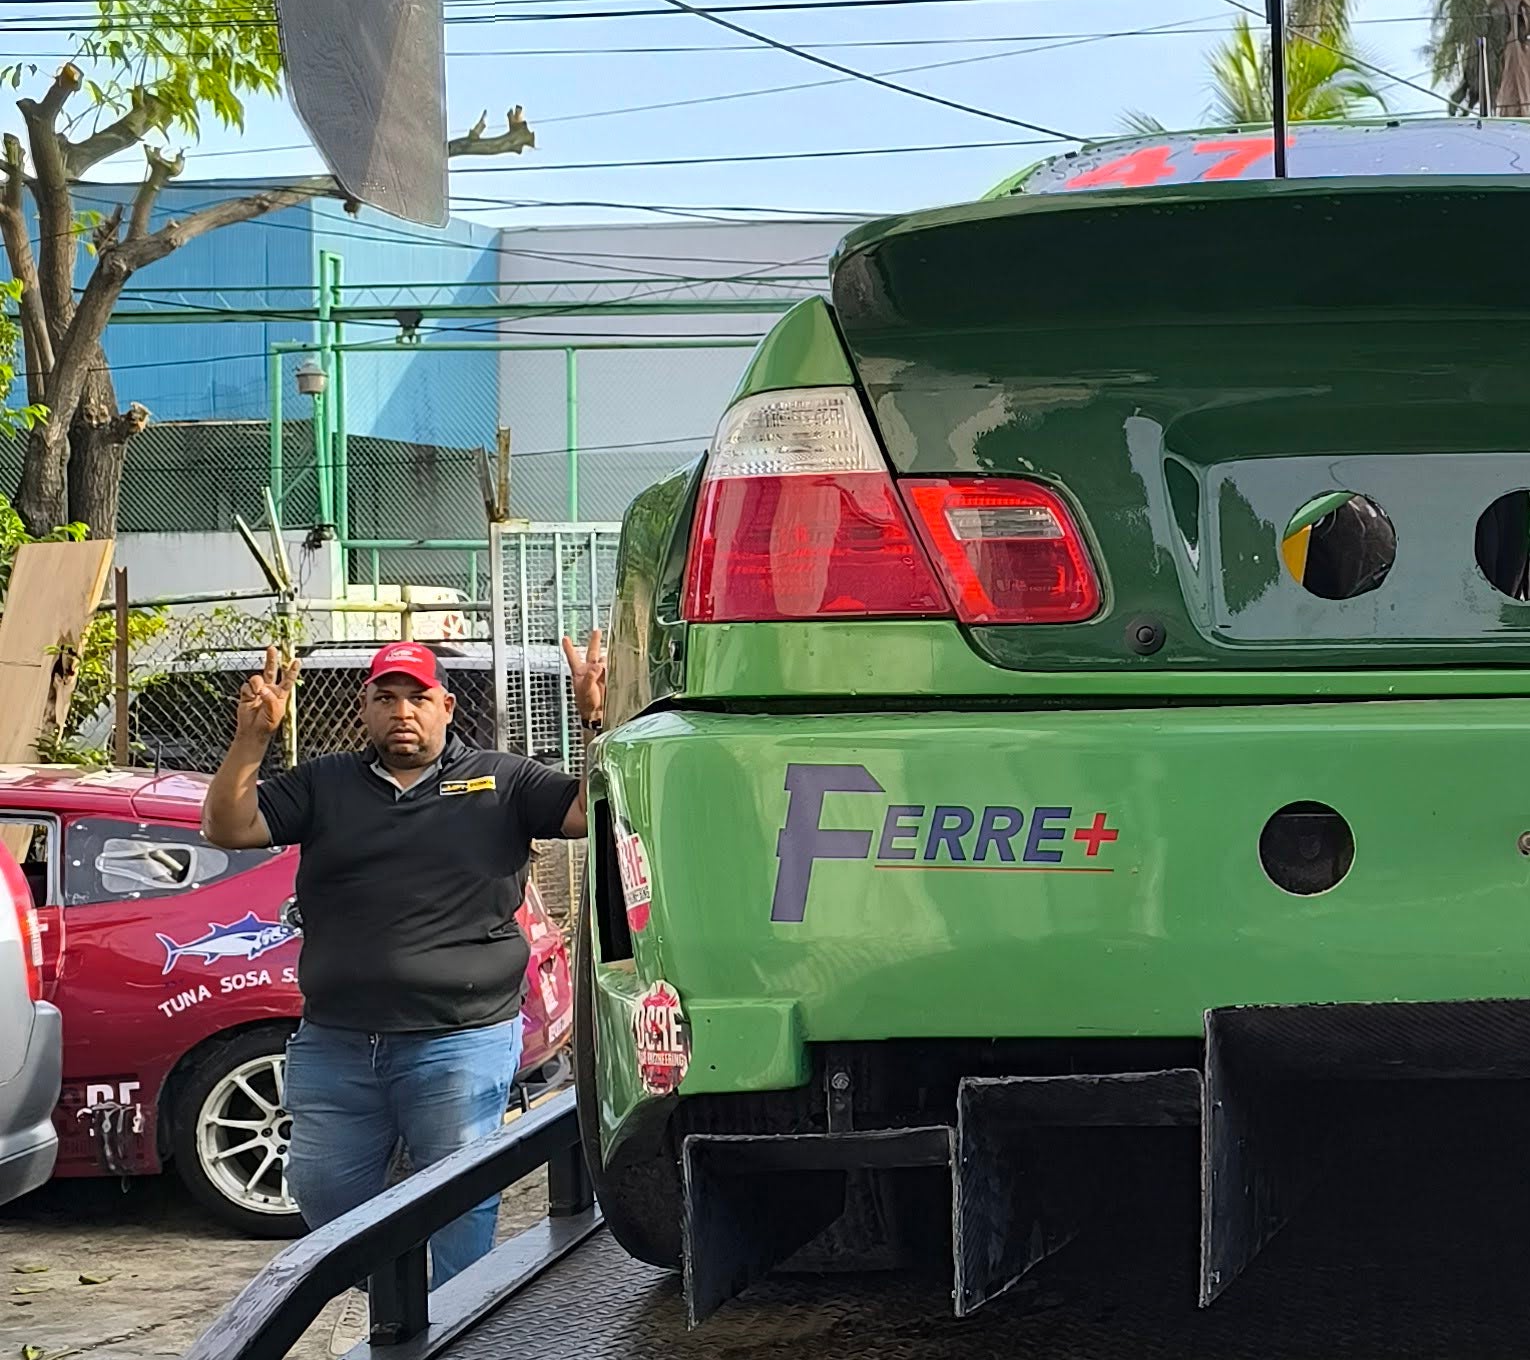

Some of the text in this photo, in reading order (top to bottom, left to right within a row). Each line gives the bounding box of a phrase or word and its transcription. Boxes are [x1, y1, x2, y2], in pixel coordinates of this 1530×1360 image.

[1064, 136, 1296, 189] 47
[157, 984, 212, 1018] TUNA
[220, 969, 272, 993] SOSA
